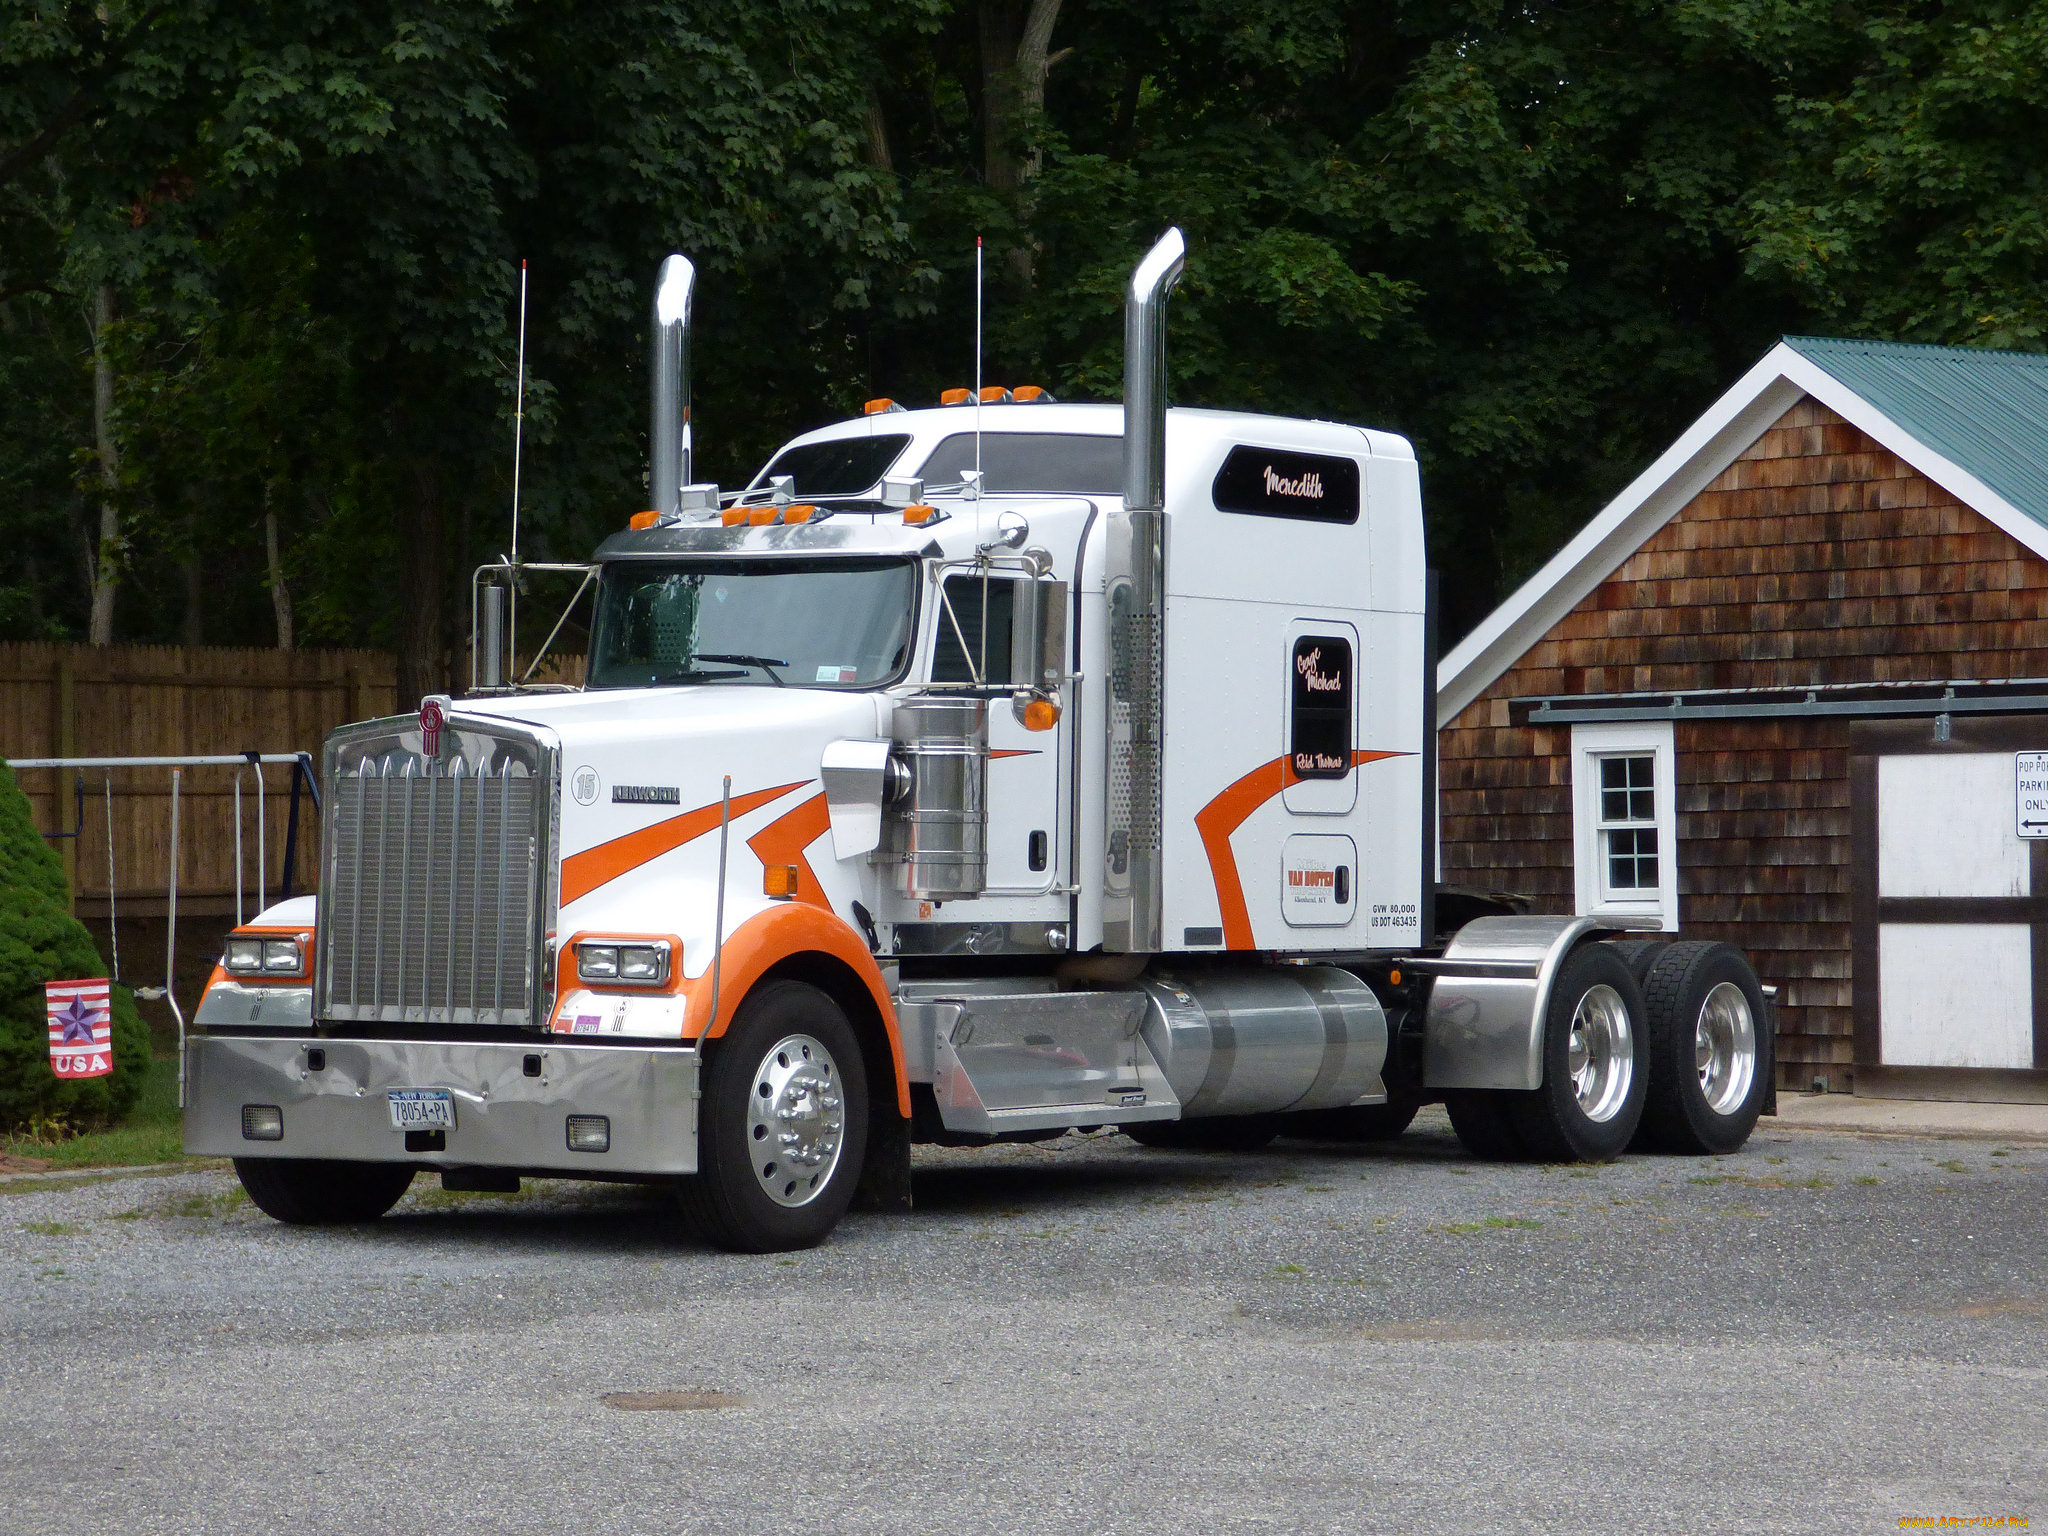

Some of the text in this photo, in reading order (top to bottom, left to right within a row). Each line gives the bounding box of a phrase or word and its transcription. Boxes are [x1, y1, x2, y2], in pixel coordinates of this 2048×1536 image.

[1263, 464, 1324, 499] Meredith
[2019, 761, 2034, 772] POP
[612, 785, 680, 803] KENWORTH
[1288, 870, 1304, 887] VAN
[1372, 904, 1416, 915] GVW 80,000
[1371, 916, 1417, 927] US DOT 463435
[55, 1054, 109, 1073] USA
